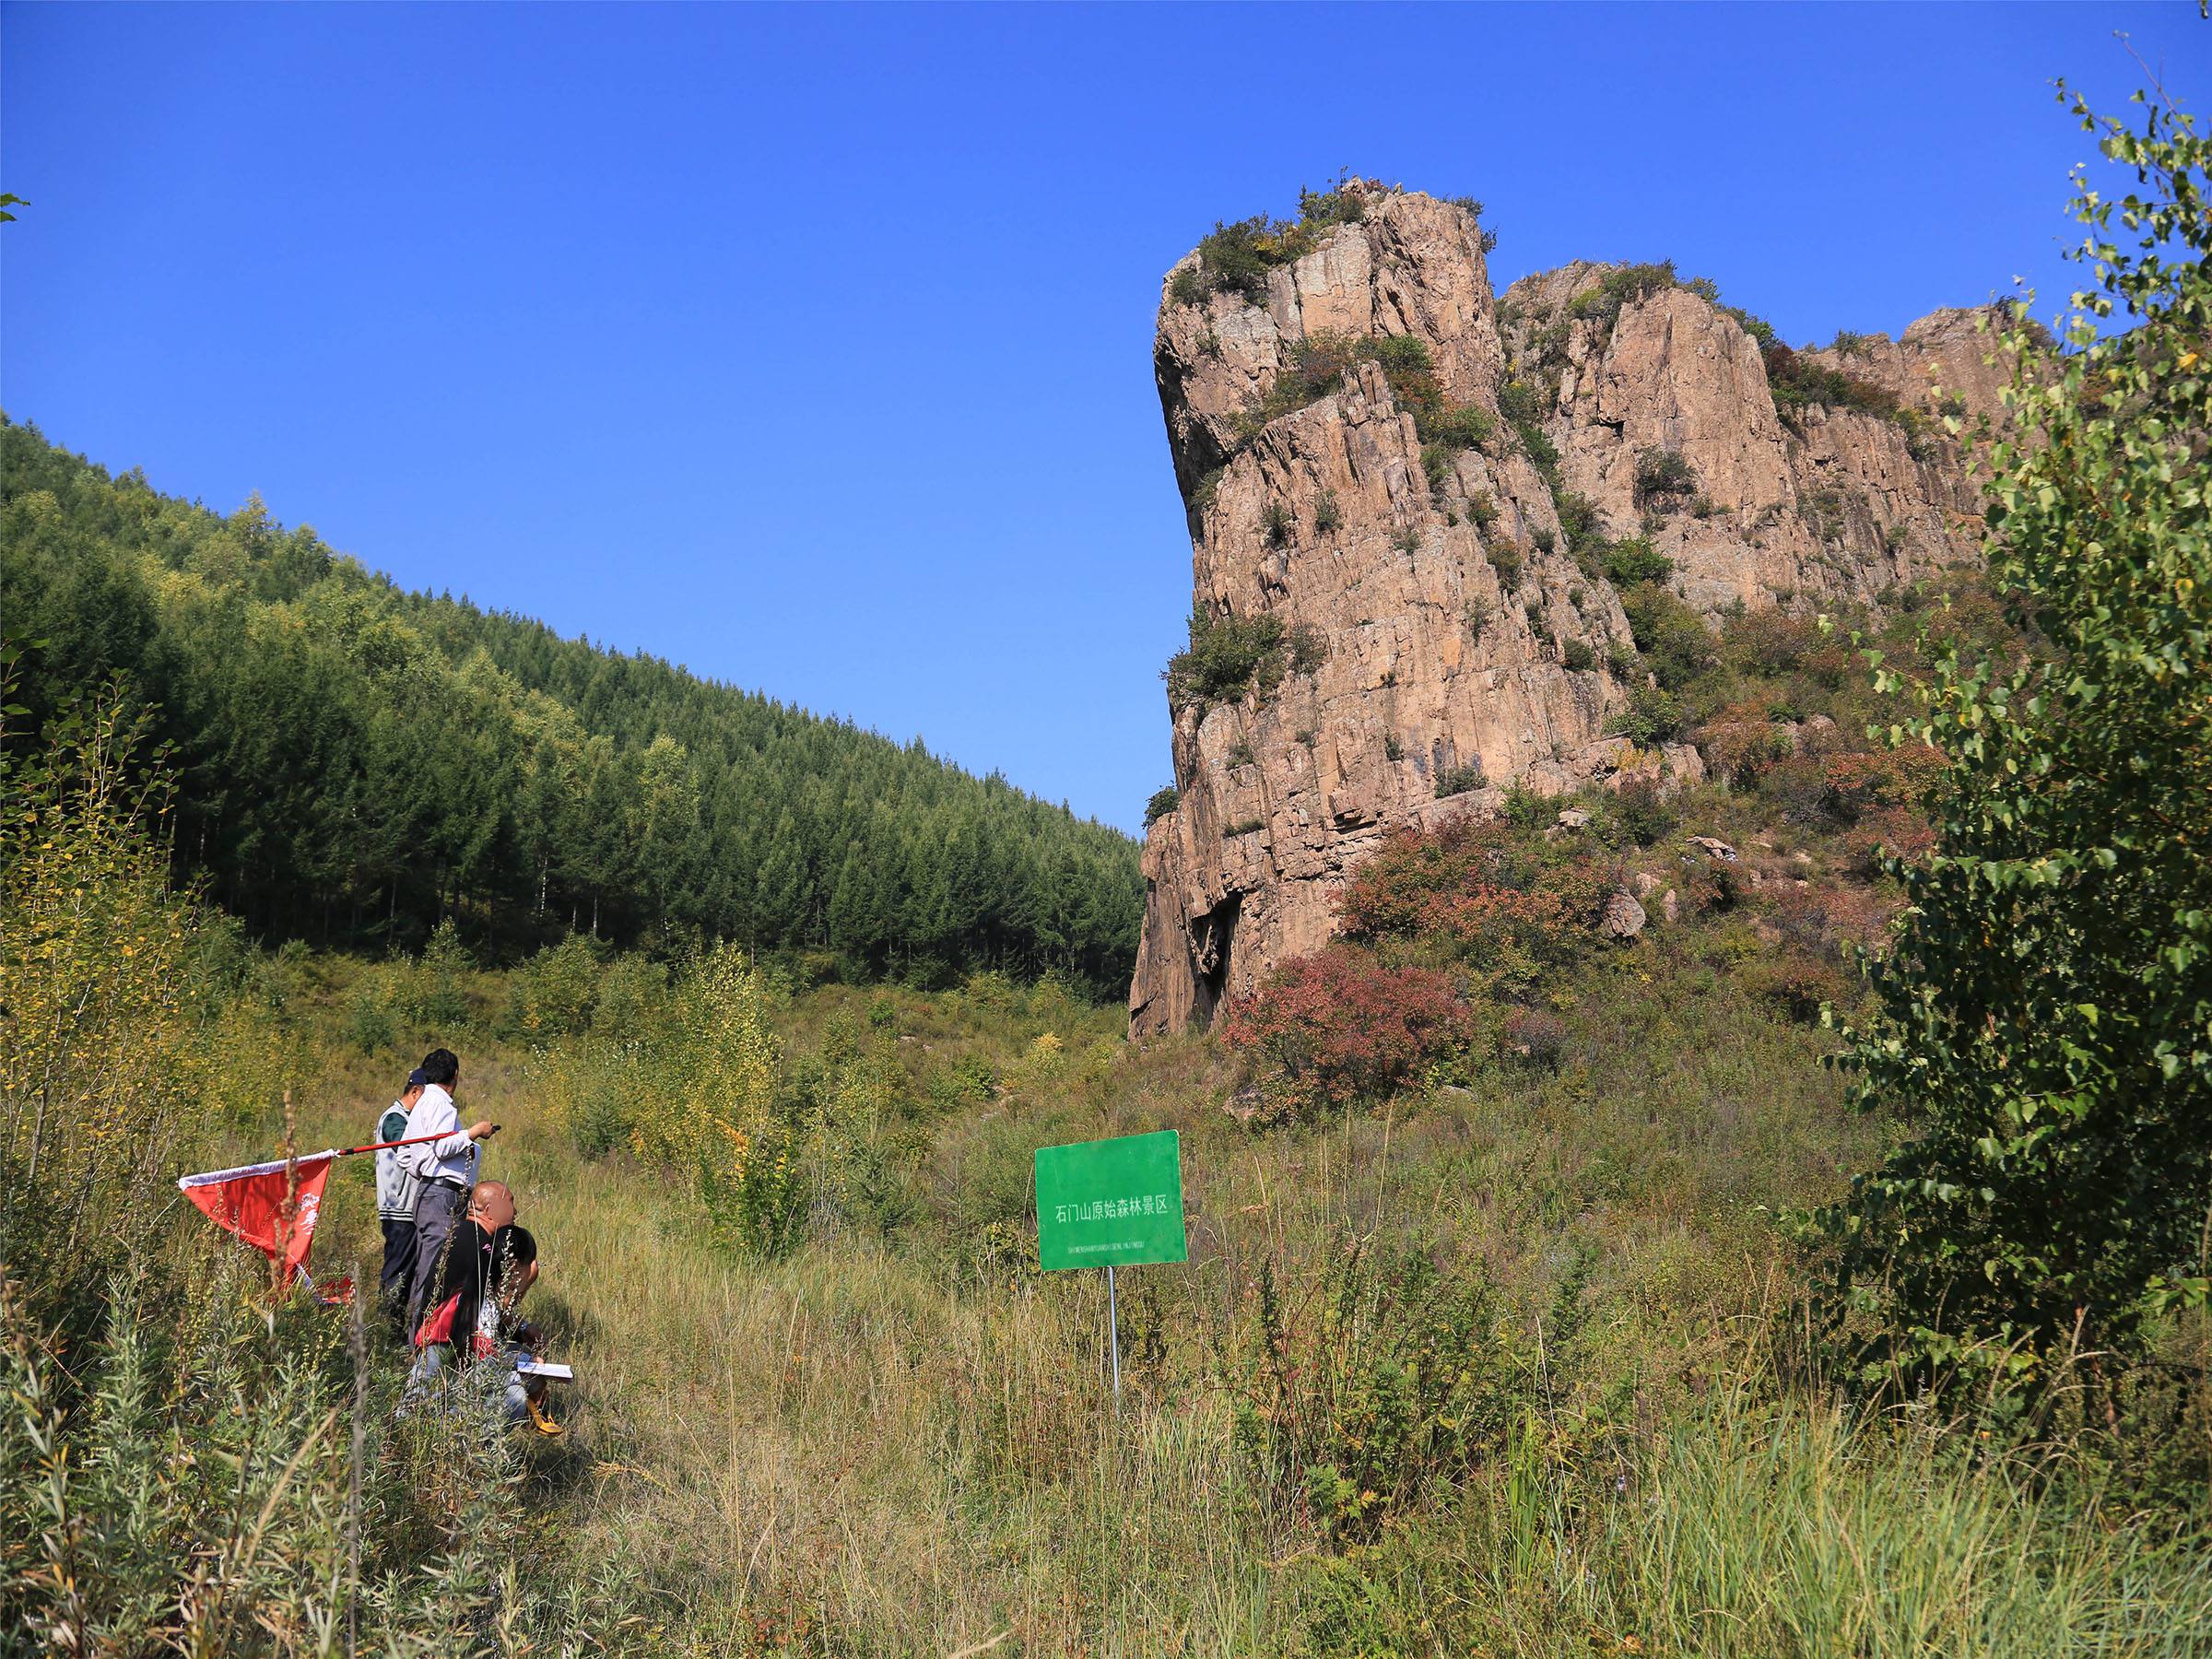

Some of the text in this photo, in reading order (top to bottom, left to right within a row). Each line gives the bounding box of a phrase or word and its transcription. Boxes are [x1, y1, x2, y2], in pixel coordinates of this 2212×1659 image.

[1055, 1194, 1168, 1224] 石门山原始森林景区
